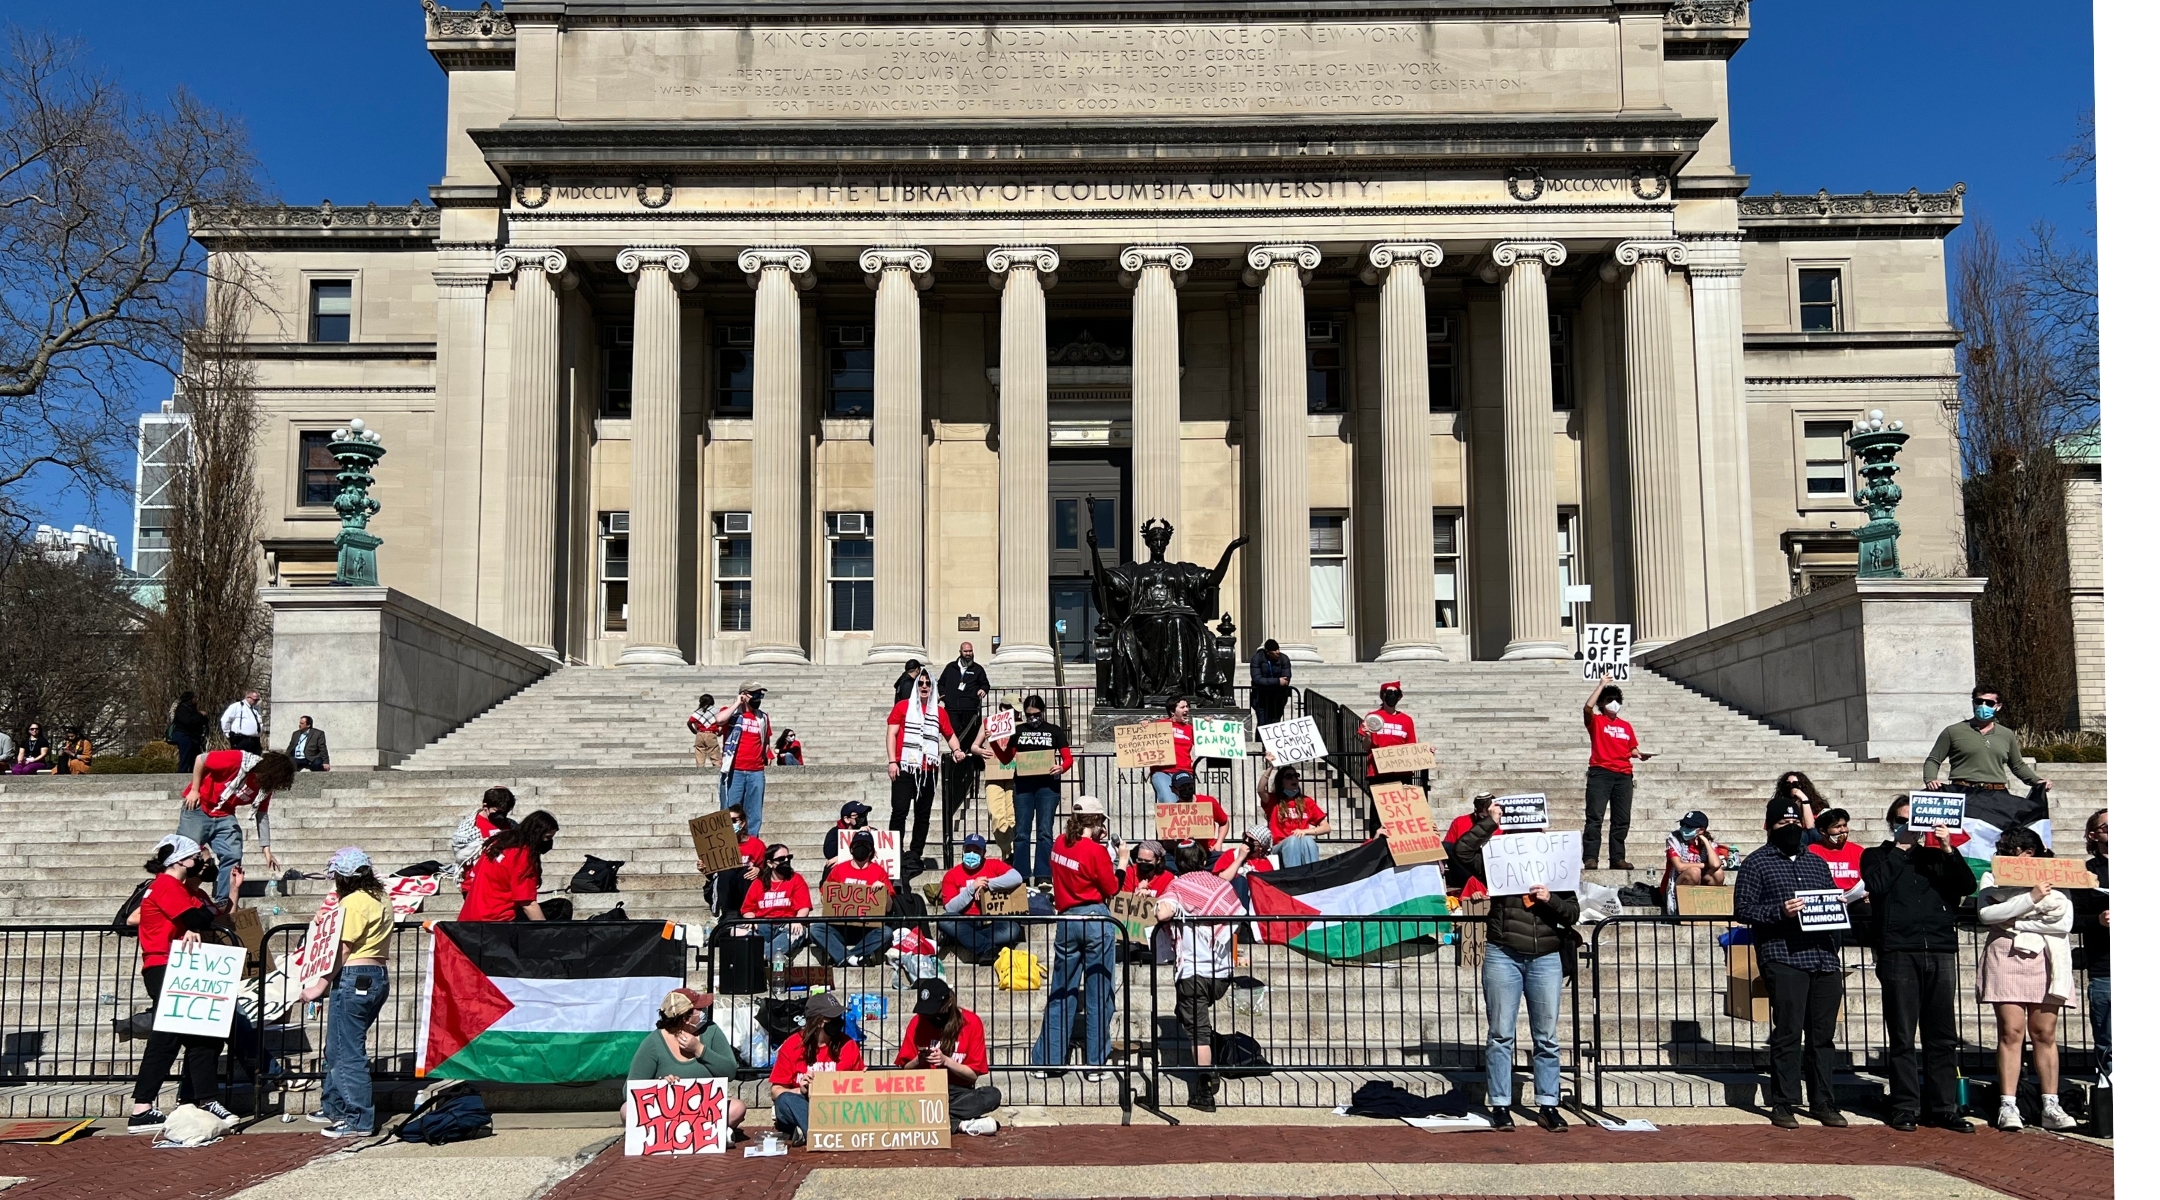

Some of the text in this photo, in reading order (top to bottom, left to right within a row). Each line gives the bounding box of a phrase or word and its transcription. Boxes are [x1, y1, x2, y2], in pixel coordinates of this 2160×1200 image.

[762, 27, 1416, 48] KING'S COLLEGE FOUNDED IN THE PROVINCE OF NEW YORK
[891, 48, 1284, 63] BY ROYAL CHARTER IN THE REIGN OF GEORGE II
[737, 62, 1443, 81] PERPETUATED AS COLUMBIA COLLEGE BY THE PEOPLE OF THE STATE OF NEW YORK
[660, 79, 1521, 97] WHEN THEY BECAME FREE AND INDEPENDENT MAINTAINED AND CHERISHED FROM GENERATION TO GENERATION
[772, 95, 1405, 112] FOR THE ADVANCEMENT OF THE PUBLIC GOOD AND THE GLORY OF ALMIGHTY GOD
[557, 186, 631, 199] MDCCLIV
[807, 178, 1373, 202] THE LIBRARY OF COLUMBIA UNIVERSITY
[1588, 627, 1626, 645] ICE
[1588, 646, 1624, 662] OFF
[1584, 661, 1628, 680] CAMPUS
[1195, 719, 1215, 733] ICE
[1223, 722, 1243, 734] OFF
[1262, 719, 1313, 741] ICE OFF
[1018, 739, 1053, 747] NAME
[1118, 740, 1170, 749] DEPORTATION
[1132, 733, 1167, 741] AGAINST
[1196, 735, 1236, 746] CAMPUS
[1275, 734, 1312, 749] CAMPUS
[1137, 750, 1165, 763] 1933
[1220, 748, 1243, 757] NOW
[1277, 743, 1317, 763] NOW!
[1376, 744, 1430, 759] ICE OFF OUR
[1379, 757, 1433, 770] CAMPUS NOW
[1117, 772, 1152, 784] ALM
[1195, 772, 1230, 784] ATER
[1378, 786, 1420, 806] JEWS
[1912, 796, 1963, 806] FIRST, THEY
[1156, 804, 1198, 818] JEWS
[1385, 804, 1413, 819] SAY
[1500, 814, 1543, 824] BROTHER
[1915, 806, 1960, 815] CAME FOR
[692, 813, 731, 838] NO ONE
[1170, 815, 1214, 827] AGAINST
[1383, 817, 1430, 837] FREE
[1913, 816, 1960, 826] MAHMOUD
[705, 832, 726, 851] IS
[877, 830, 894, 850] IN
[1161, 827, 1191, 839] ICE!
[1389, 835, 1441, 854] MAHMOUD
[1488, 834, 1570, 860] ICE OFF
[700, 846, 741, 874] ILLEGAL
[2000, 857, 2074, 868] PROTECT THE
[1489, 860, 1569, 889] CAMPUS
[2014, 867, 2090, 886] STUDENTS
[827, 885, 879, 906] FUCK
[1803, 895, 1821, 904] IRST,
[987, 901, 1005, 911] OFF
[1825, 904, 1841, 912] FOR
[313, 910, 339, 941] ICE
[1803, 914, 1845, 923] MAHMOUD
[309, 936, 332, 958] OFF
[170, 951, 236, 975] JEWS
[300, 950, 334, 980] CAMPUS
[169, 976, 233, 995] AGAINST
[164, 994, 226, 1021] ICE
[832, 1076, 926, 1095] WE WERE
[631, 1079, 725, 1127] FUCK
[817, 1099, 947, 1125] STRANGERS TOO.
[642, 1114, 719, 1155] ICE
[813, 1131, 939, 1149] ICE OFF CAMPUS
